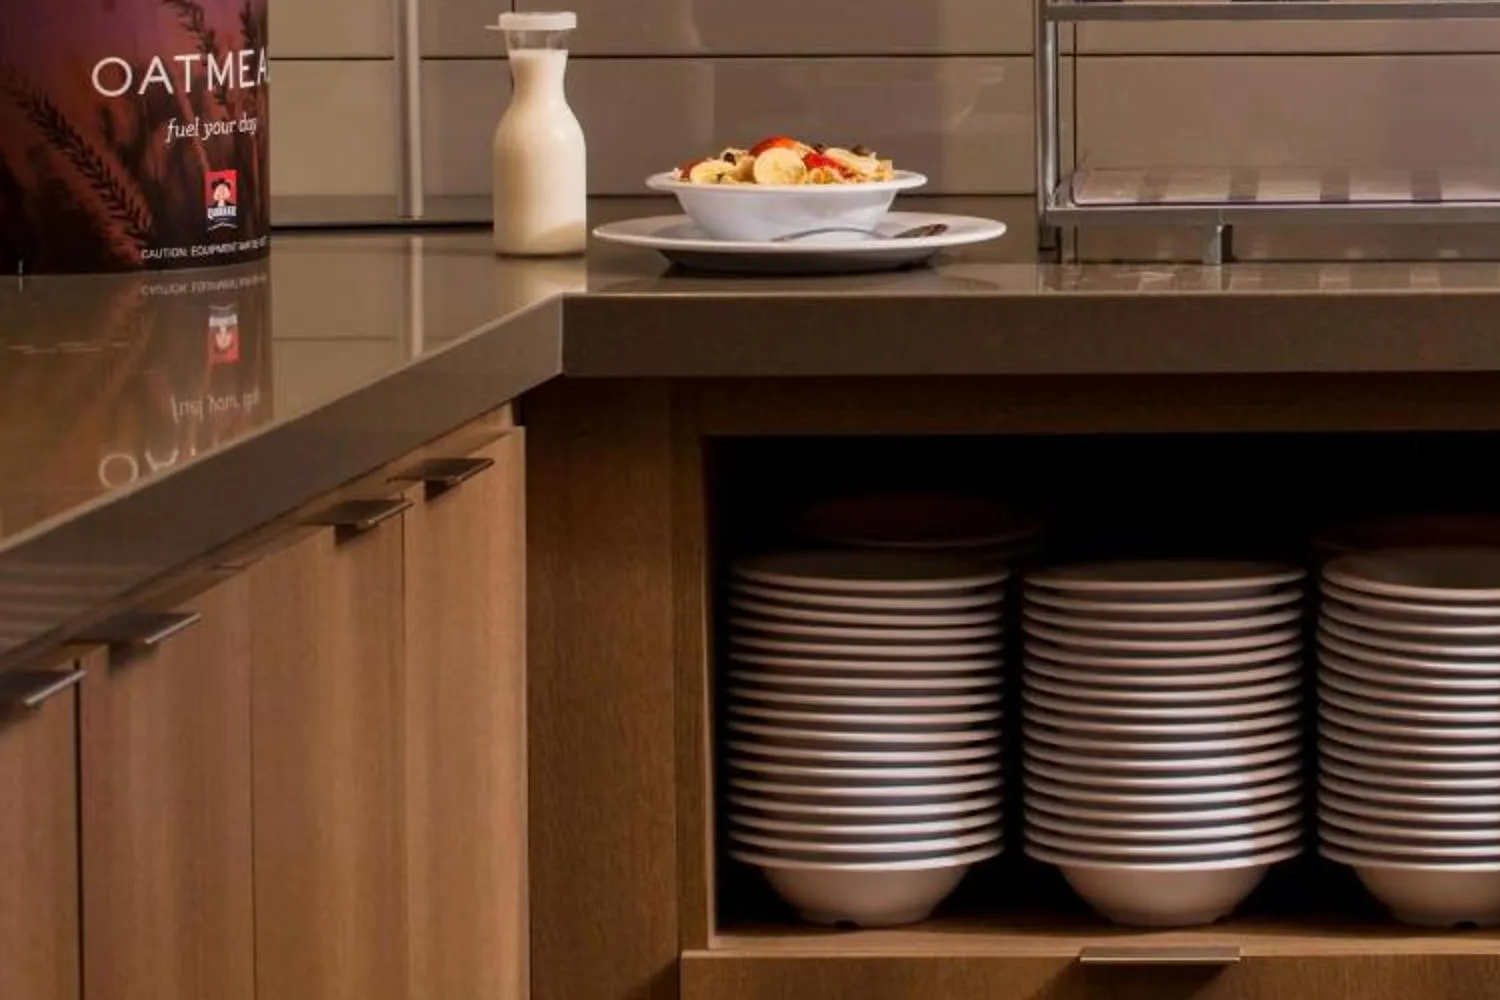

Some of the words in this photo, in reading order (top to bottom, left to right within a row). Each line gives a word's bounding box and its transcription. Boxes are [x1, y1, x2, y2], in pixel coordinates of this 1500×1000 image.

[166, 116, 200, 143] fuel
[201, 120, 237, 141] your
[238, 112, 257, 136] day
